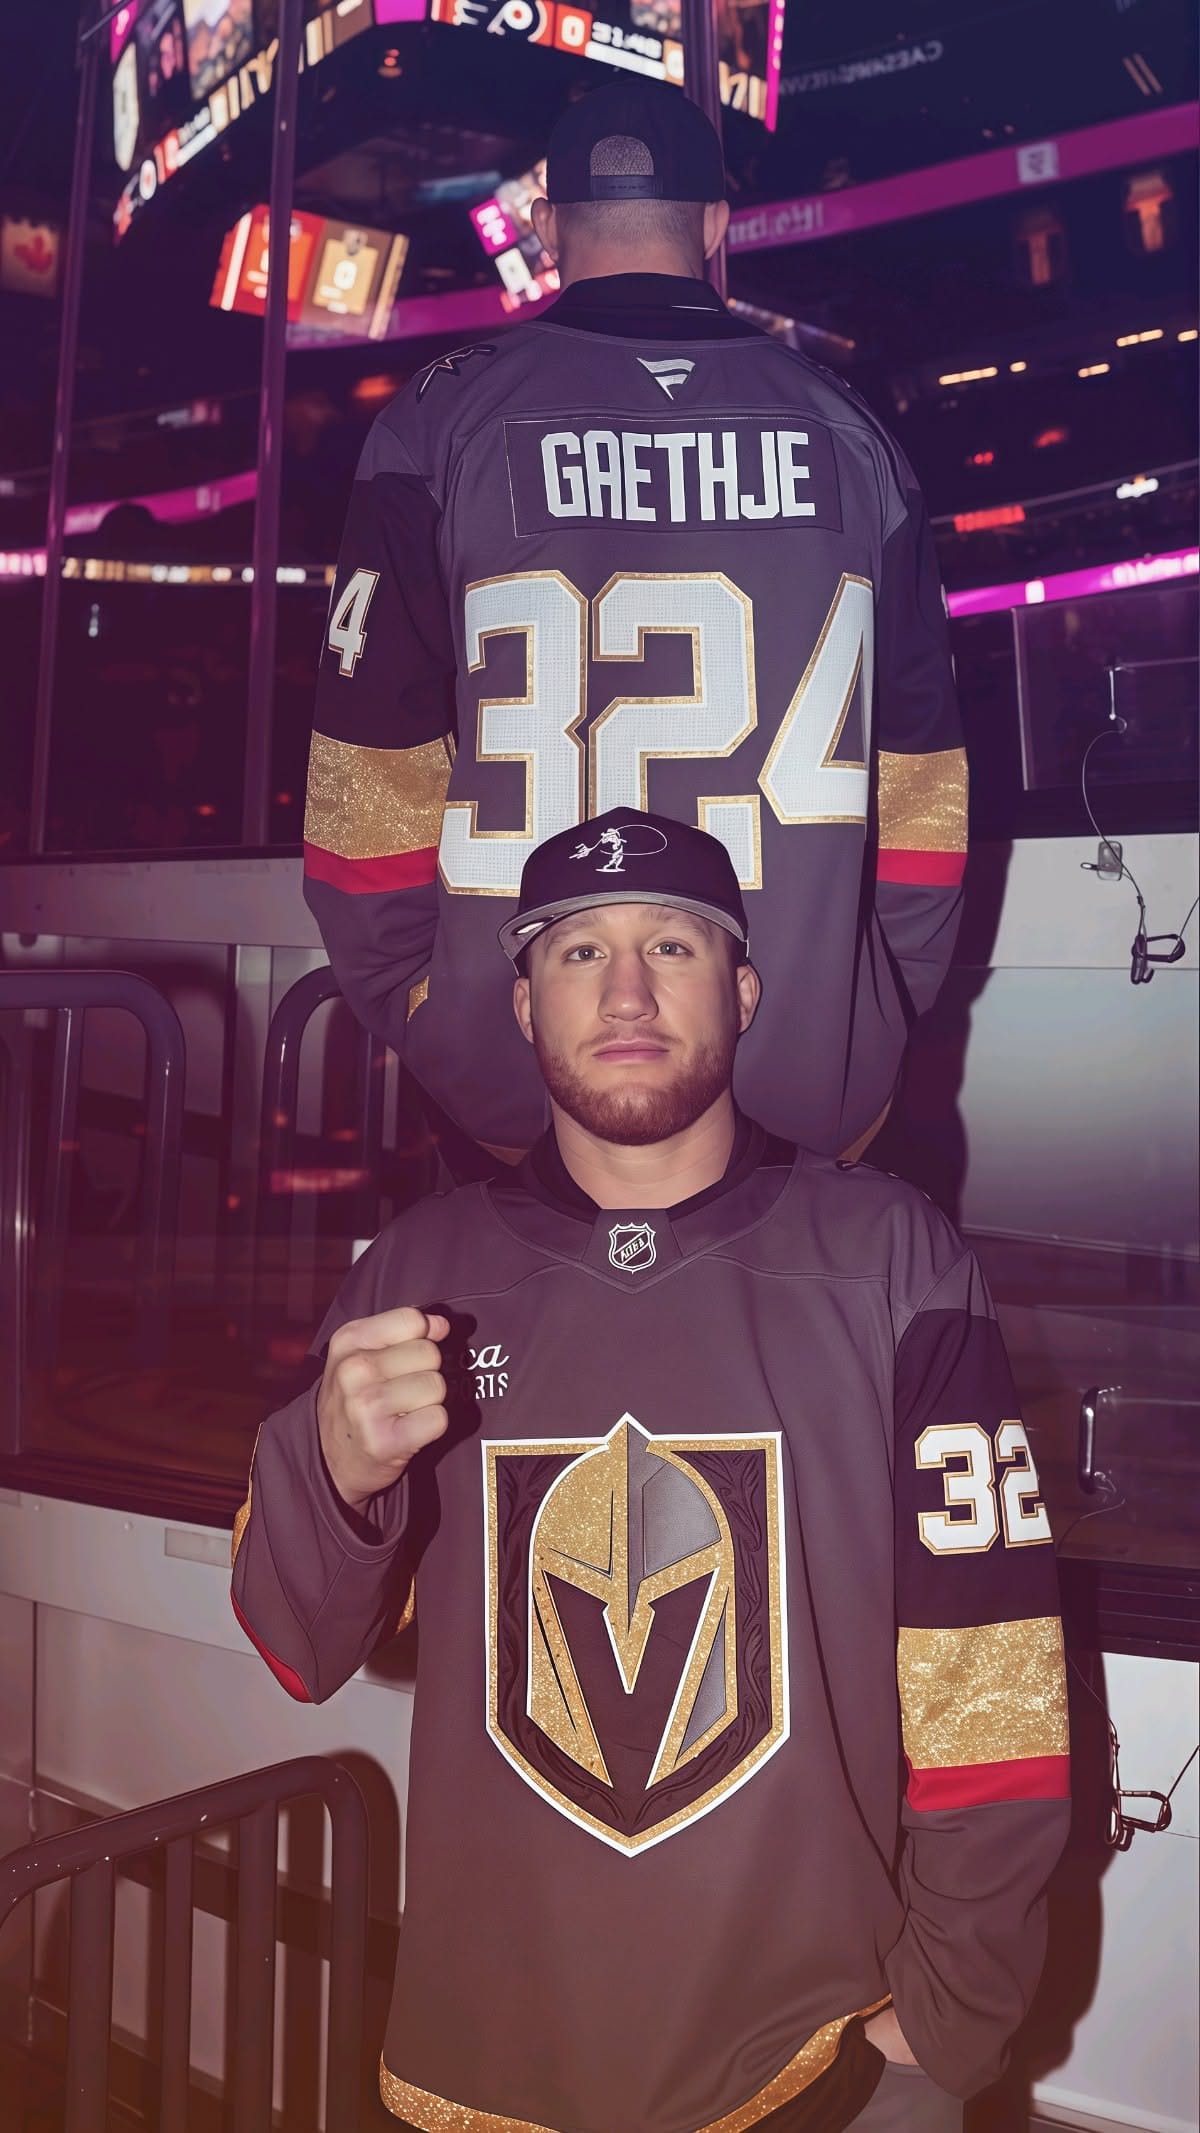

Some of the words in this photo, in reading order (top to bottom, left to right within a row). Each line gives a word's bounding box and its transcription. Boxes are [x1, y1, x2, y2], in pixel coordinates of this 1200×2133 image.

[540, 430, 816, 523] GAETHJE
[438, 570, 873, 896] 324
[914, 1419, 1053, 1556] 32
